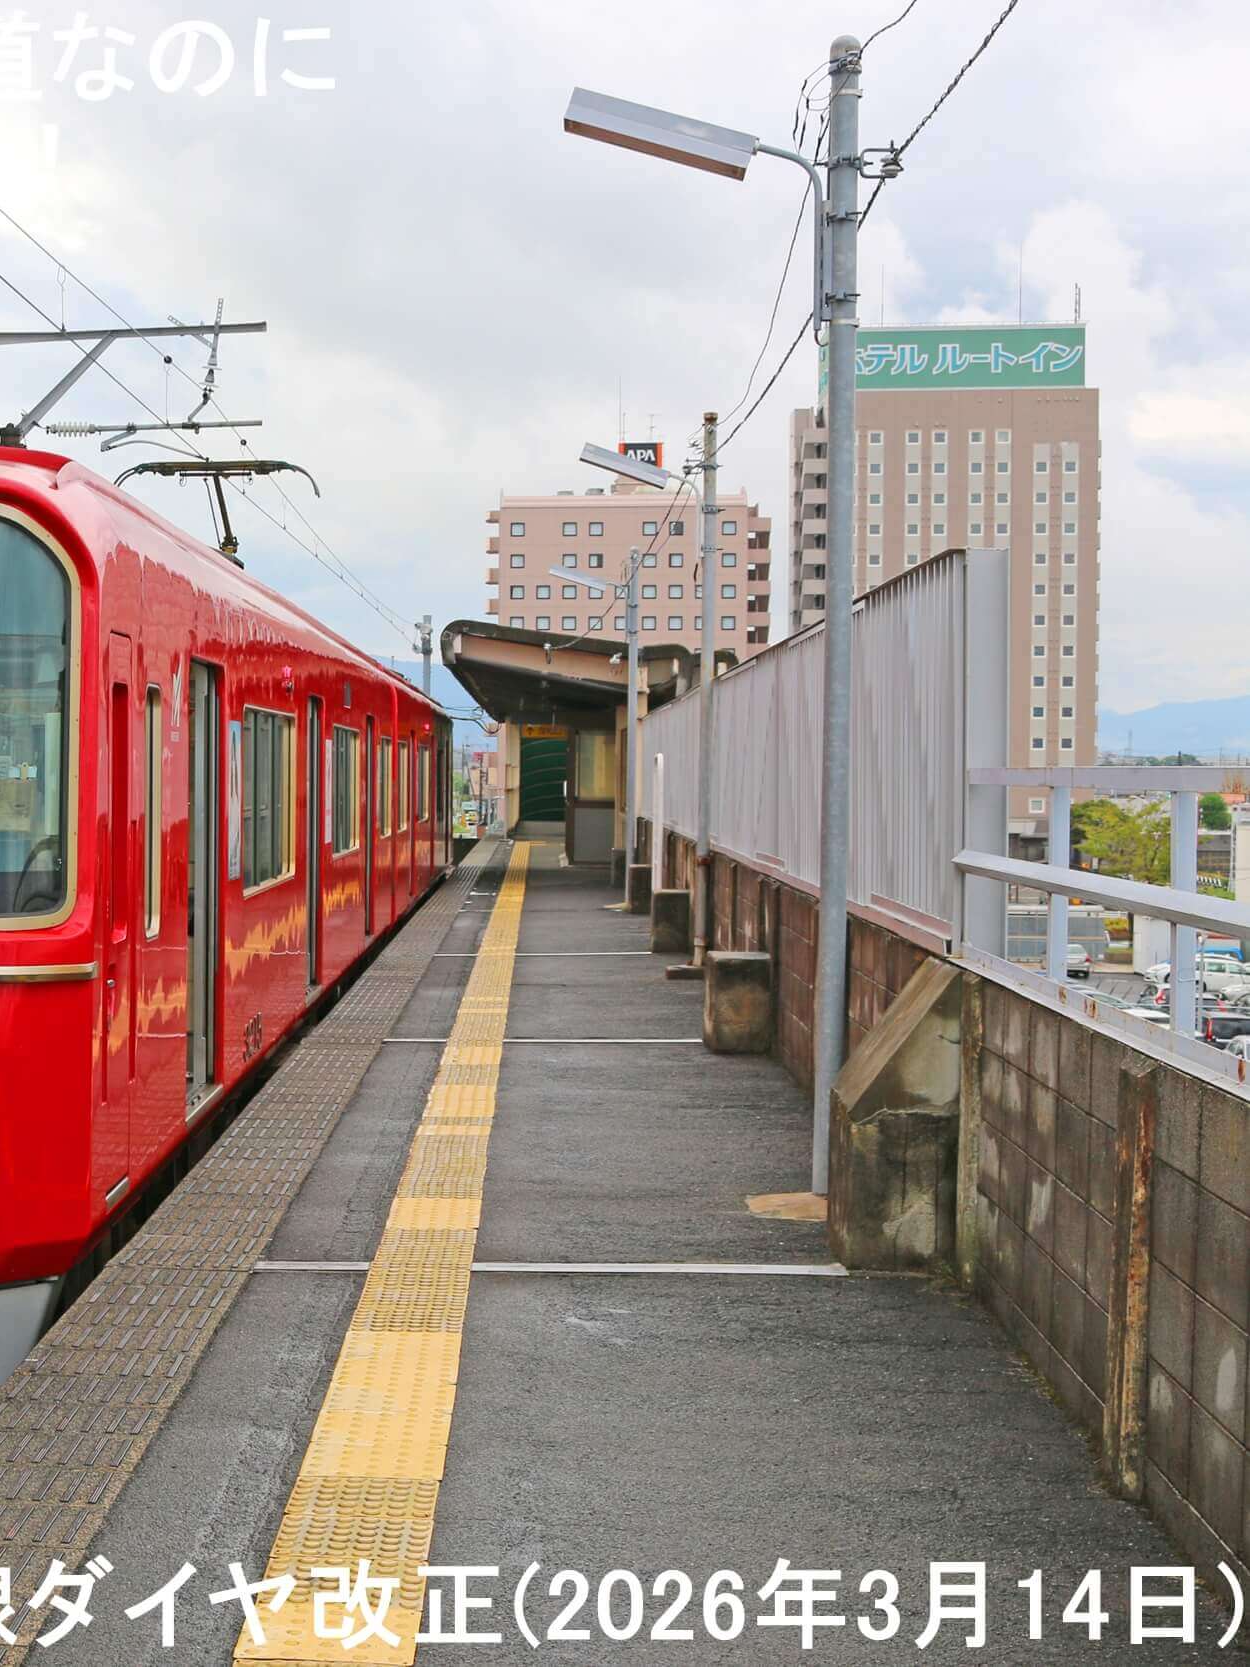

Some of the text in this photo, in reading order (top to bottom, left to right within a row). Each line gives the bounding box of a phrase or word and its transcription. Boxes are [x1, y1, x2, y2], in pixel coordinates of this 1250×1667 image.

[932, 342, 1083, 374] ルートイン
[627, 449, 656, 461] APA
